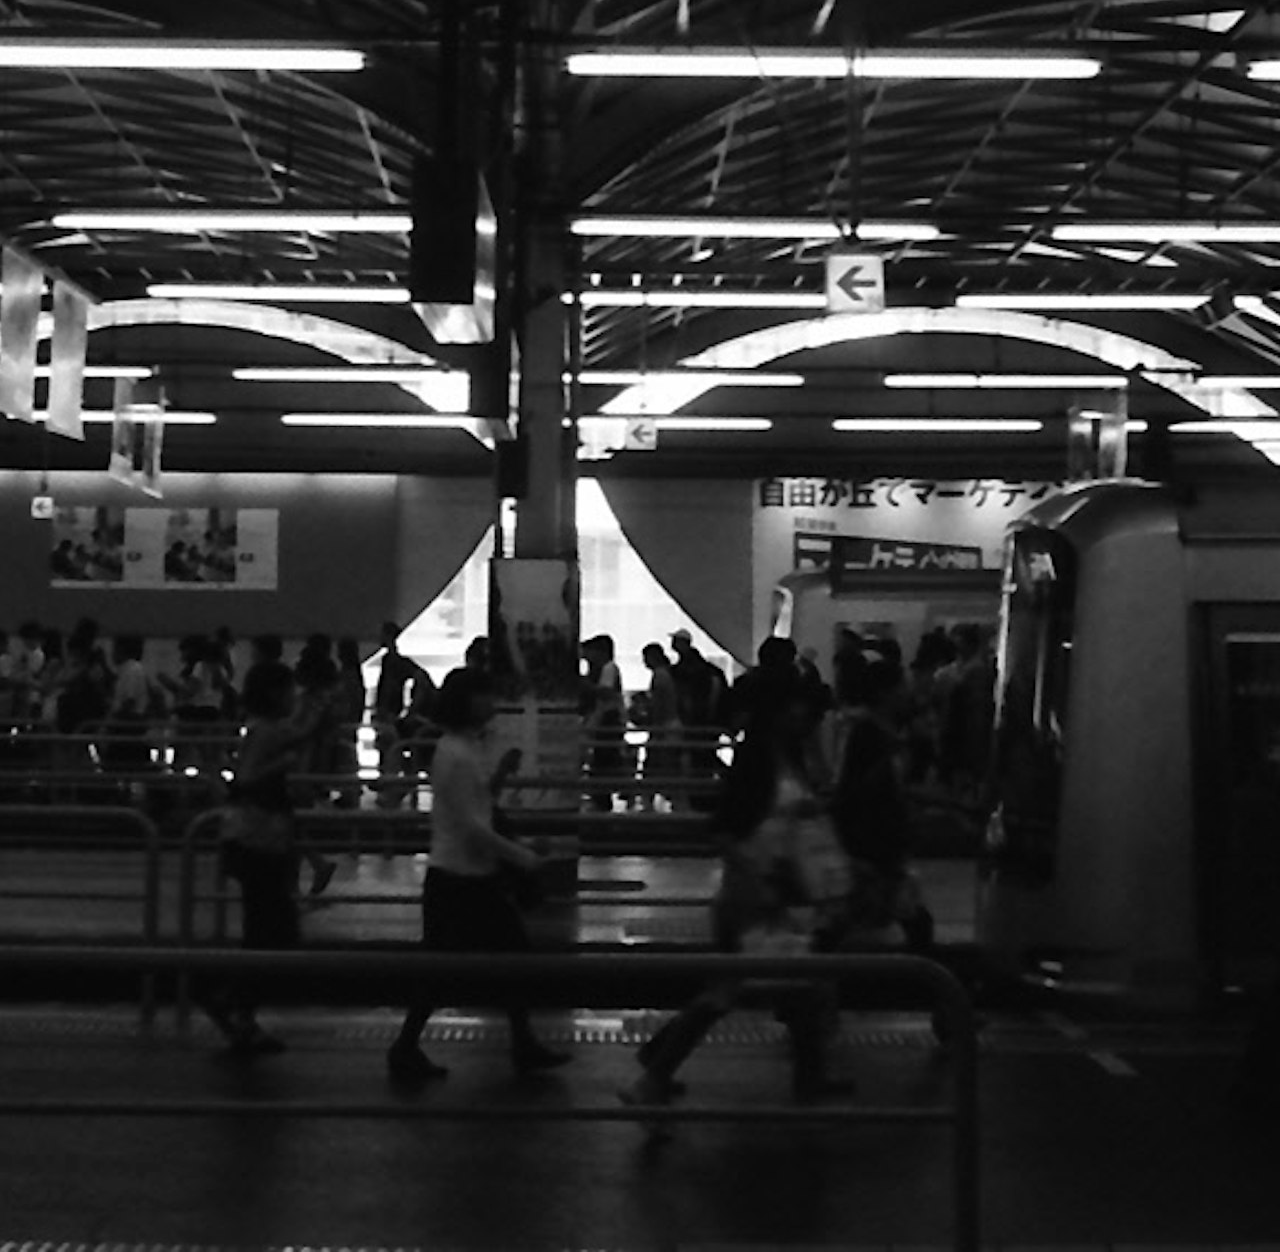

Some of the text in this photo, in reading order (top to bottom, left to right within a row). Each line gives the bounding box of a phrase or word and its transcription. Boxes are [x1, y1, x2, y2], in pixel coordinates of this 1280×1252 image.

[761, 477, 1063, 507] 自由が丘でマーケティ
